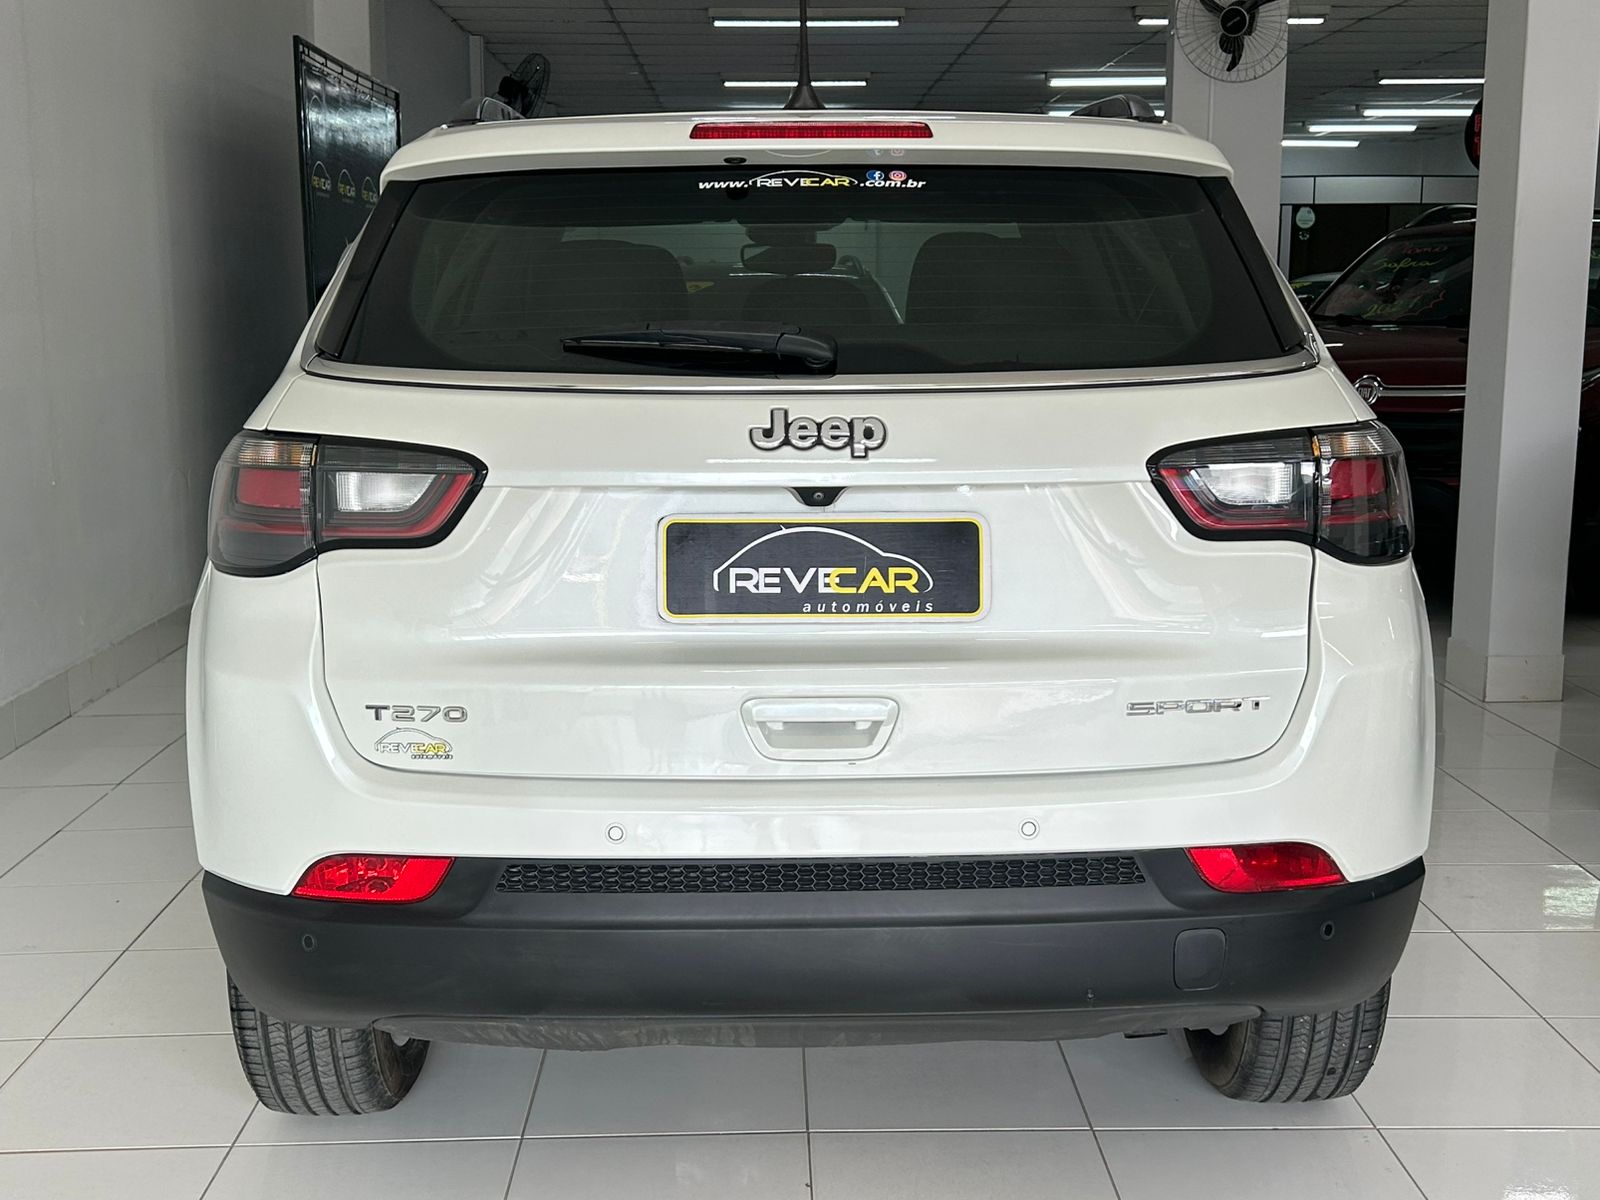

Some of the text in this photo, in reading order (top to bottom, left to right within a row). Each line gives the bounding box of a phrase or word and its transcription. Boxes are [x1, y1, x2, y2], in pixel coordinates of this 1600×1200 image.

[698, 180, 748, 189] www.
[756, 177, 850, 187] REVECAR
[749, 407, 888, 459] Jeep
[729, 567, 919, 593] REVECAR
[803, 600, 934, 613] automóveis
[365, 704, 468, 722] T270
[1126, 695, 1271, 716] SPORT
[380, 742, 447, 753] REVECAR
